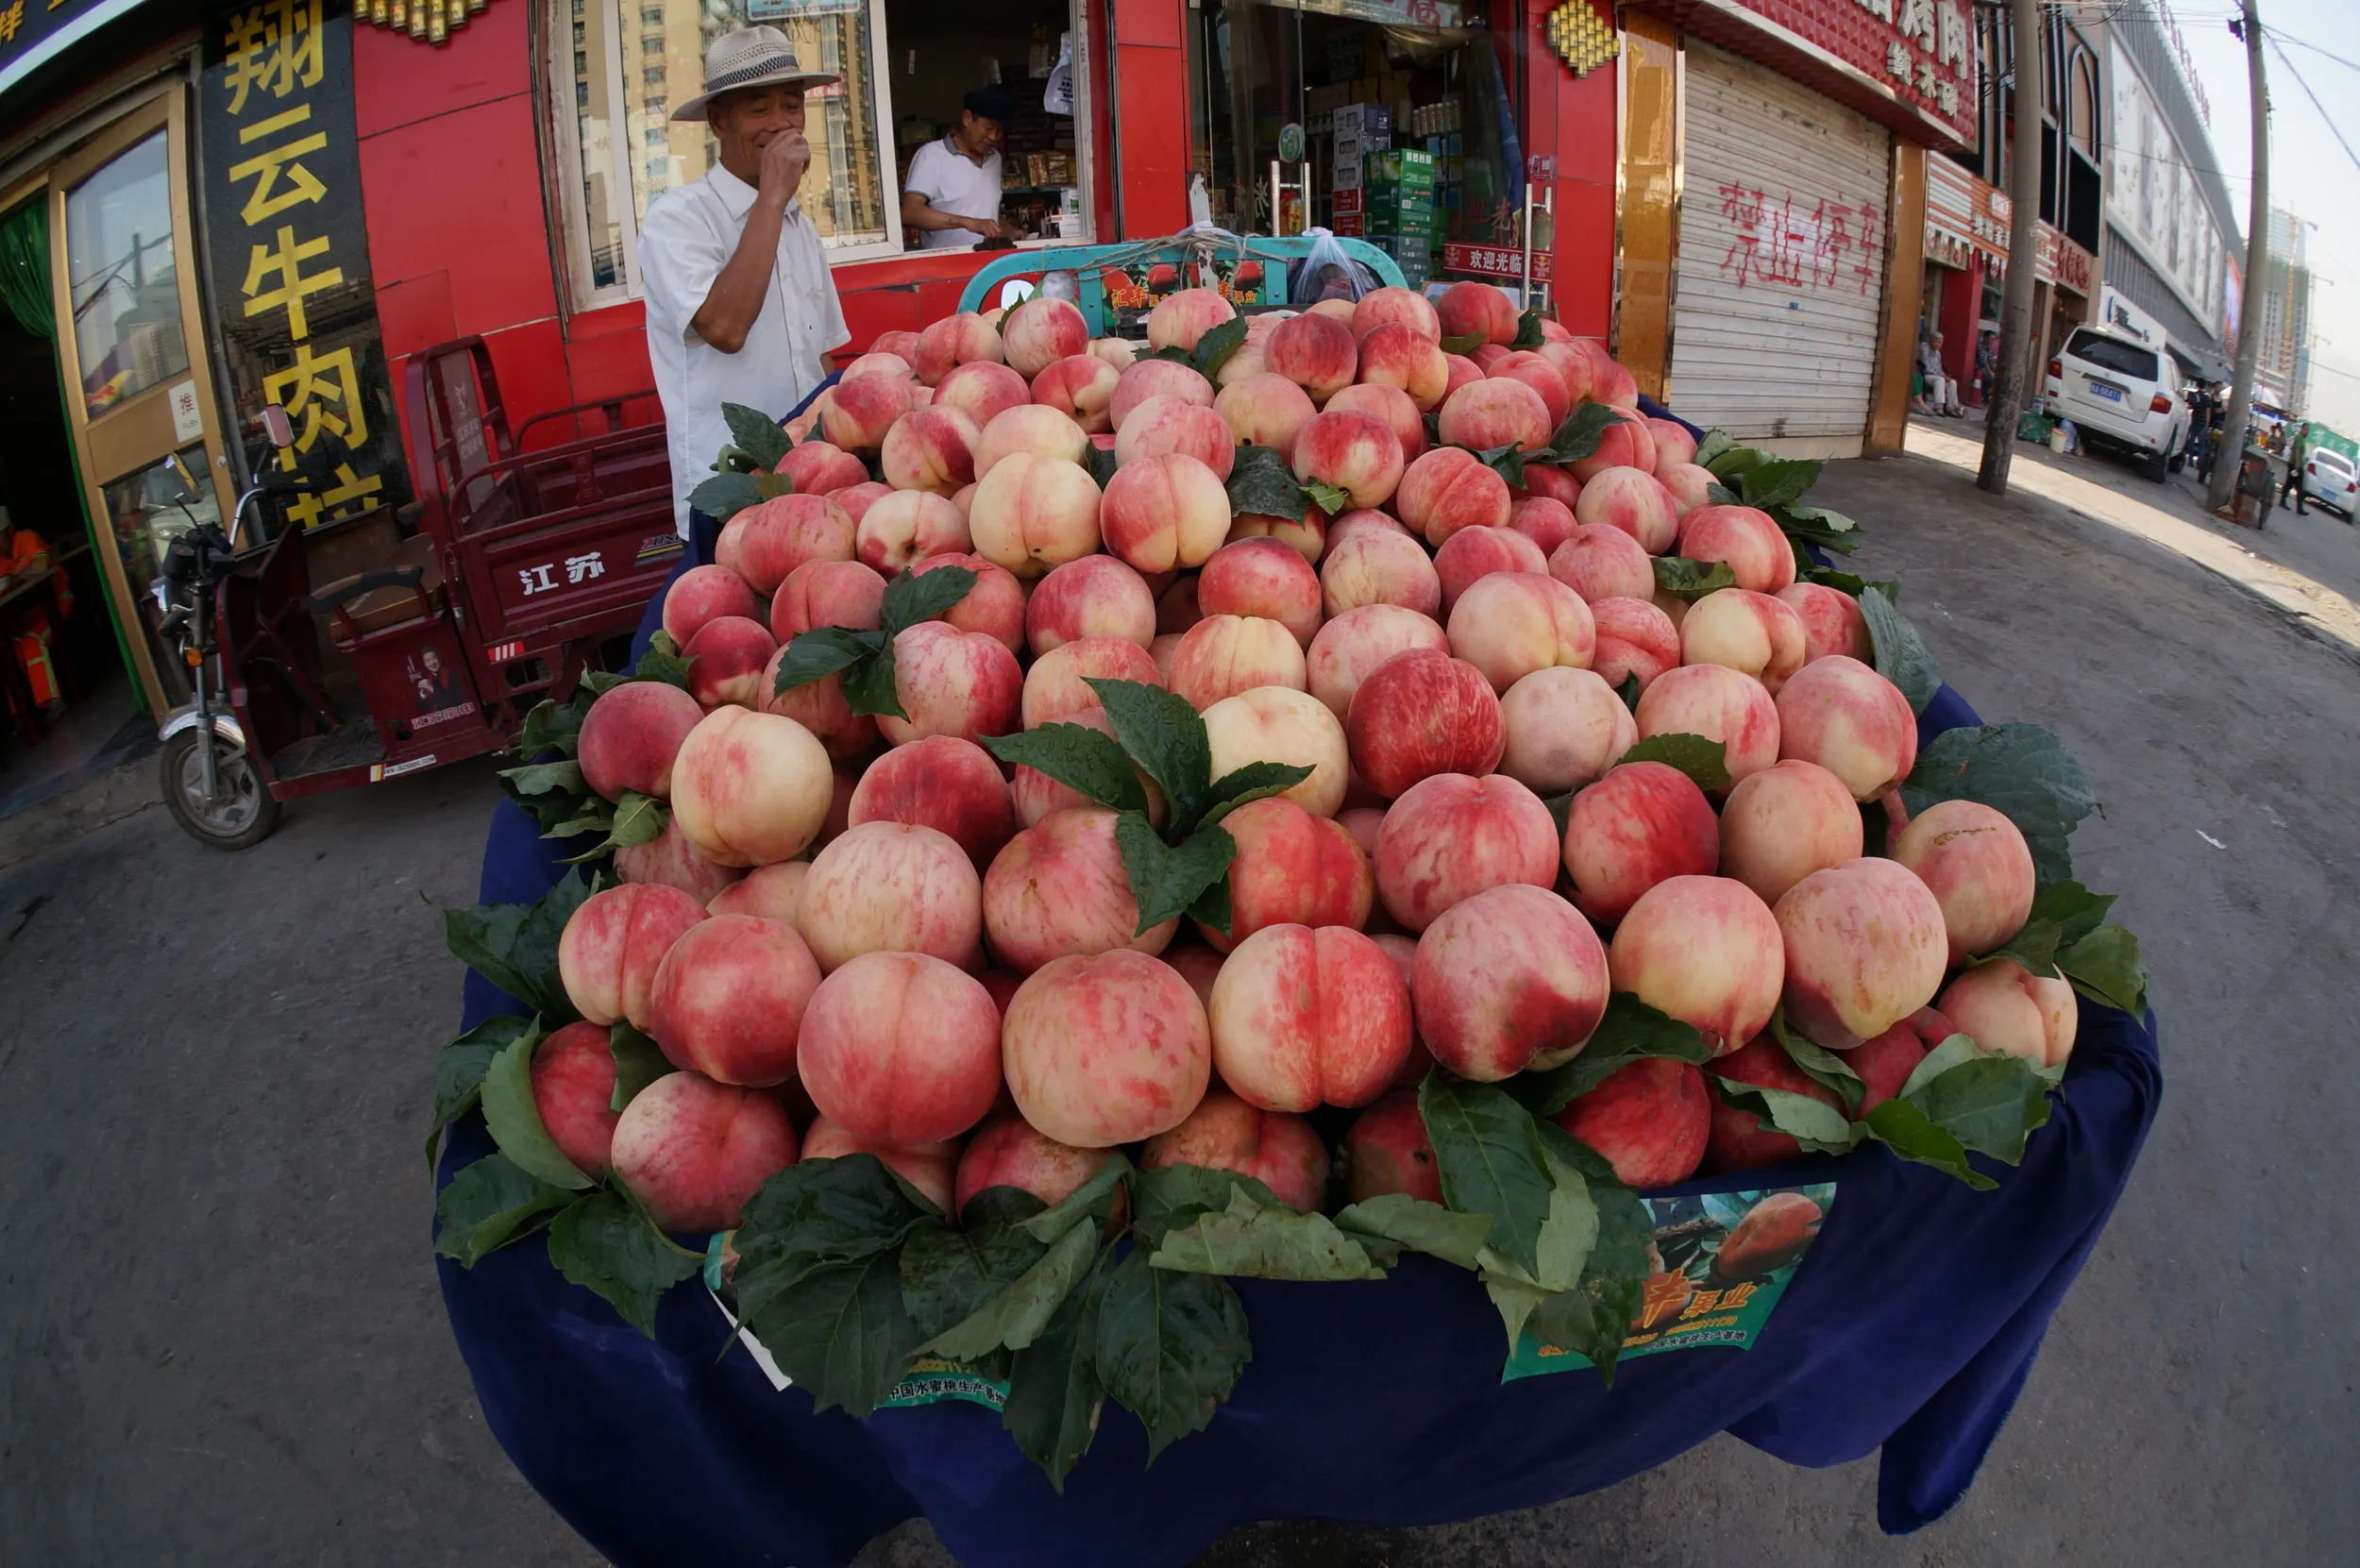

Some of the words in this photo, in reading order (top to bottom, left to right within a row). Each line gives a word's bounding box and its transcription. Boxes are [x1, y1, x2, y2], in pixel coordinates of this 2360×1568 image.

[1854, 0, 1968, 79] 烤肉
[1470, 250, 1523, 274] 欢迎光临
[1718, 178, 1879, 295] 禁止停车
[518, 551, 605, 596] 江苏
